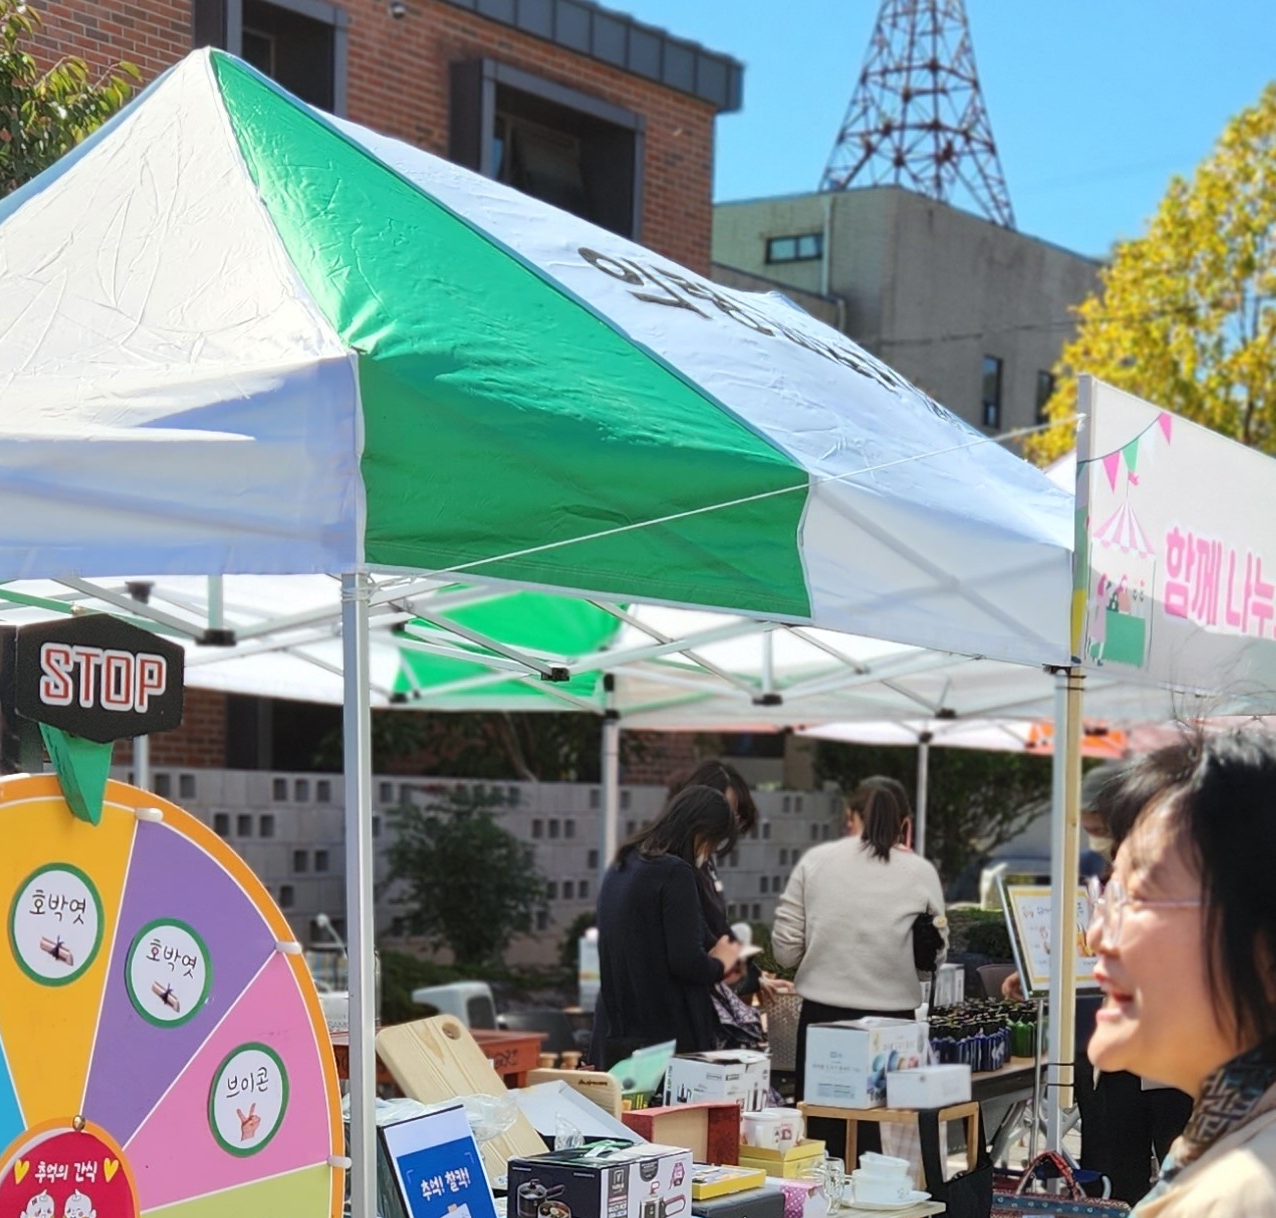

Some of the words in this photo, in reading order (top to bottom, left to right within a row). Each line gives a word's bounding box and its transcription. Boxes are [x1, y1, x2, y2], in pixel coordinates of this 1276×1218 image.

[1164, 526, 1223, 626] 함께
[40, 642, 167, 713] STOP
[29, 889, 86, 925] 호박엿
[146, 938, 197, 979] 호박엿
[226, 1066, 269, 1098] 브이콘
[35, 1161, 69, 1184] 추억의
[74, 1161, 98, 1183] 간식
[421, 1175, 445, 1201] 추억!
[445, 1167, 471, 1193] 찰칵!
